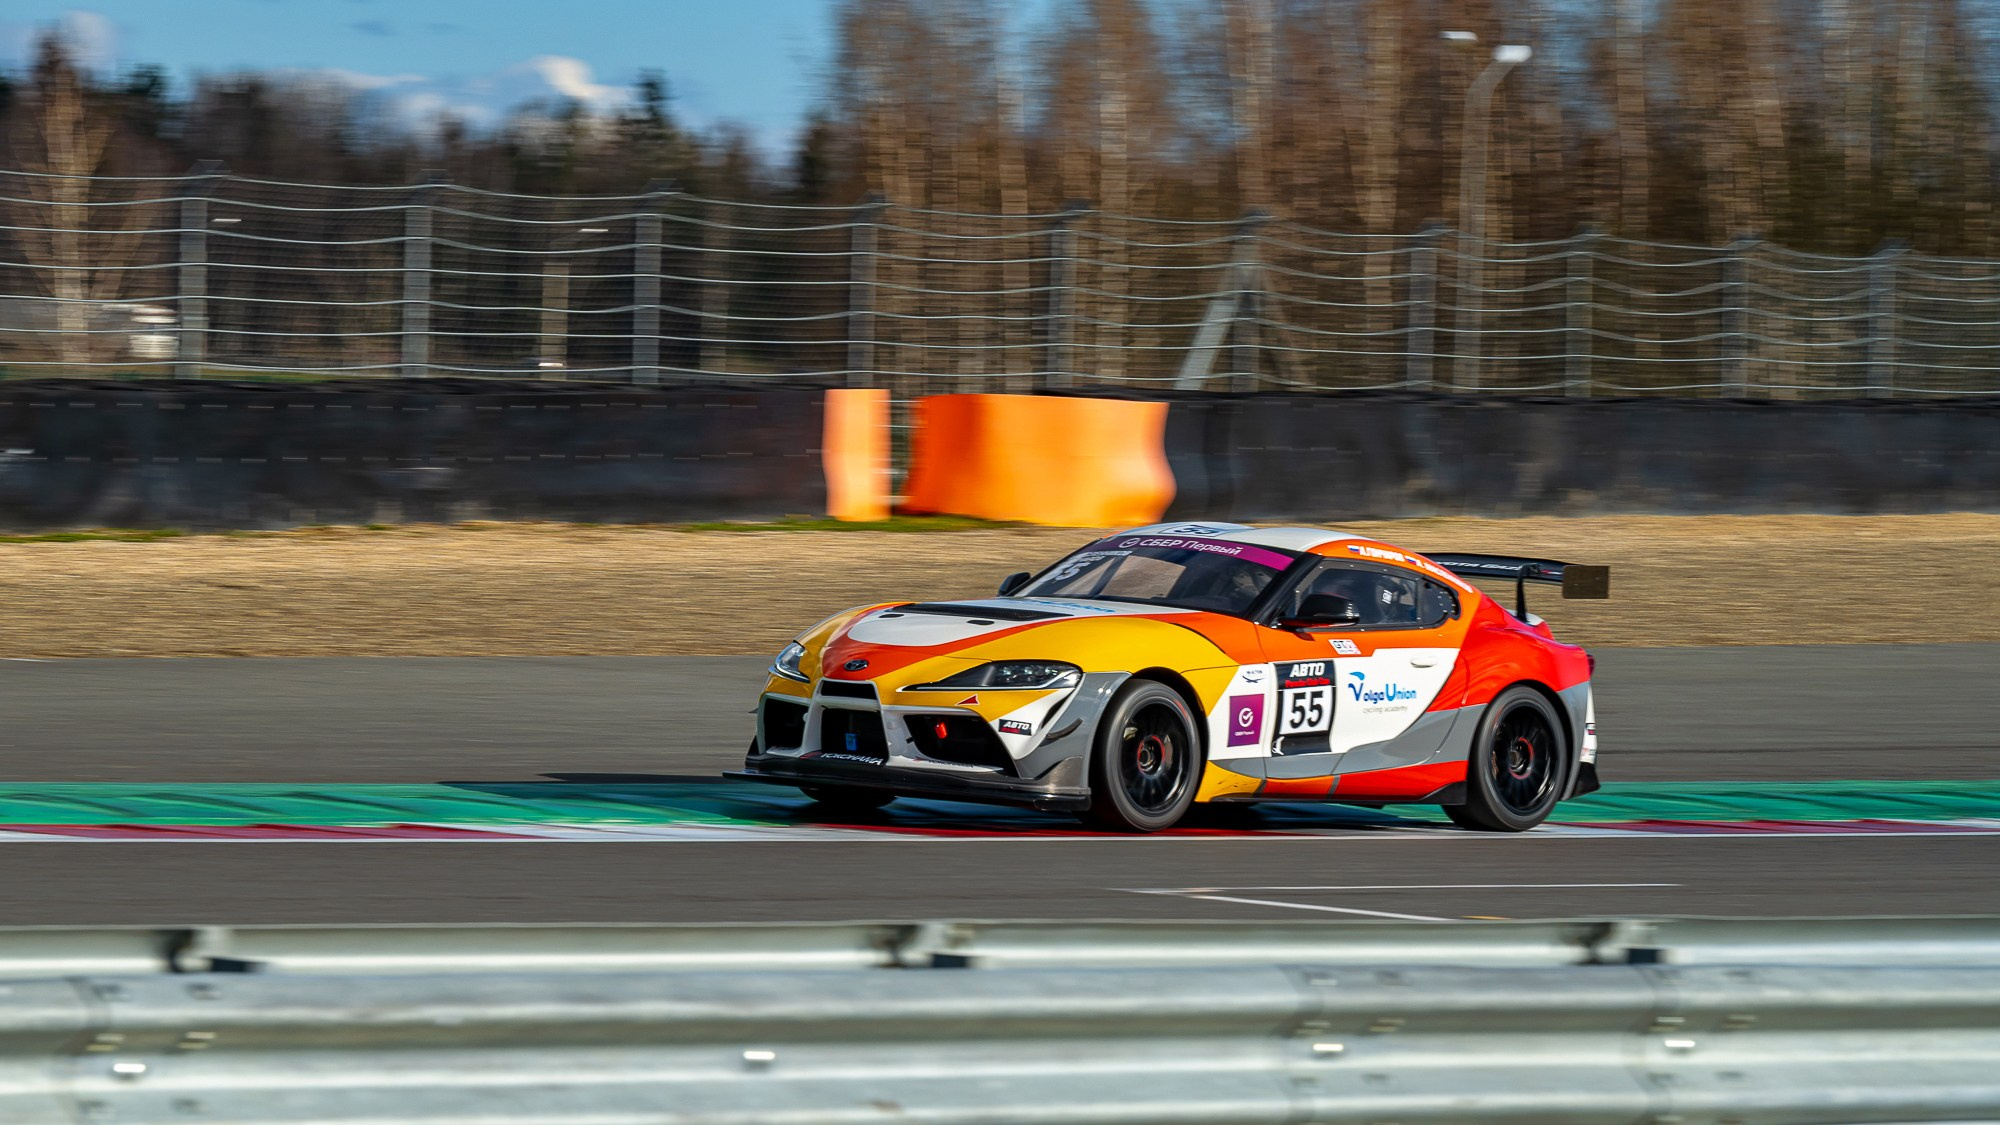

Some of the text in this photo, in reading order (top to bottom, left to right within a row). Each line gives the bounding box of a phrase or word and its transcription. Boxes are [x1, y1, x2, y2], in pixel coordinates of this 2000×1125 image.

[1139, 538, 1243, 555] СБЕР Первый
[1289, 662, 1325, 678] АВТО
[1289, 691, 1324, 729] 55
[1003, 721, 1030, 730] АВТО
[821, 753, 885, 765] YOKOHAMA
